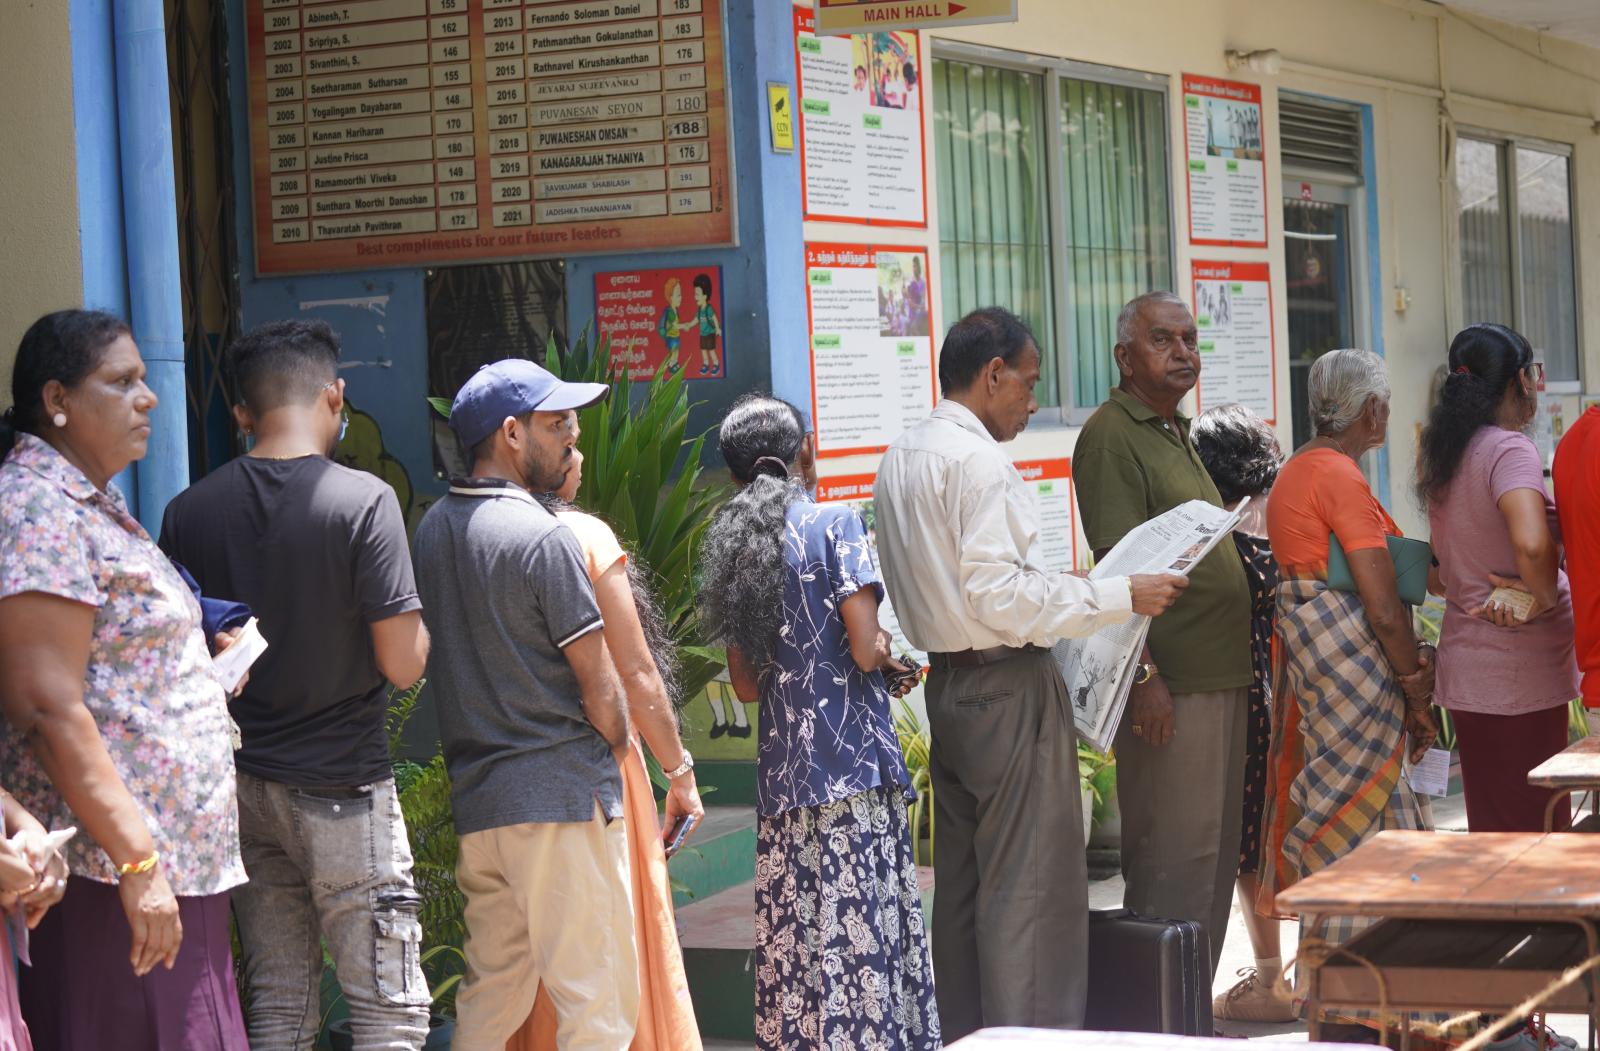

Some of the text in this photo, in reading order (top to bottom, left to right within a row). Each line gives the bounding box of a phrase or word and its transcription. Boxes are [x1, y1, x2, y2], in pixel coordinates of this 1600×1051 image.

[273, 0, 456, 27] 2001 Abinesh, T. 155
[493, 0, 690, 28] 2013 Fernando Soloman Daniel 183
[864, 4, 941, 22] MAIN HALL
[273, 22, 456, 50] 2002 Sripriya, S. 162
[494, 24, 691, 52] 2014 Pathmanathan Gokulanathan 183
[275, 47, 458, 74] 2003 Sivanthini, S. 146
[495, 49, 692, 76] 2015 Rathnavel Kirushankanthan 176
[276, 71, 459, 98] 2004 Seetharaman Sutharsan 155
[497, 90, 517, 100] 2016
[679, 73, 692, 82] 177
[276, 95, 460, 121] 2005 Yogalingam Dayabaran 148
[498, 96, 701, 125] 2017 PUVANESAN SEYON 180
[277, 119, 461, 144] 2006 Kannan Hariharan 170
[499, 122, 699, 149] 2018 PUWANESHAN OMSAN 188
[279, 143, 462, 168] 2007 Justine Prisca 180
[500, 147, 695, 173] 2019 KANAGARAJAH THANIYA 176
[280, 167, 463, 192] 2008 Ramamoorthi Viveka 149
[502, 186, 522, 197] 2020
[680, 173, 692, 181] 191
[281, 191, 465, 215] 2009 Sunthara Moorthi Danushan 178
[503, 210, 523, 221] 2021
[679, 198, 692, 206] 176
[282, 228, 301, 239] 2010
[365, 220, 402, 232] Pavithran
[451, 215, 465, 225] 172
[357, 225, 622, 256] Best compliments for our future leaders
[808, 252, 815, 262] 2.
